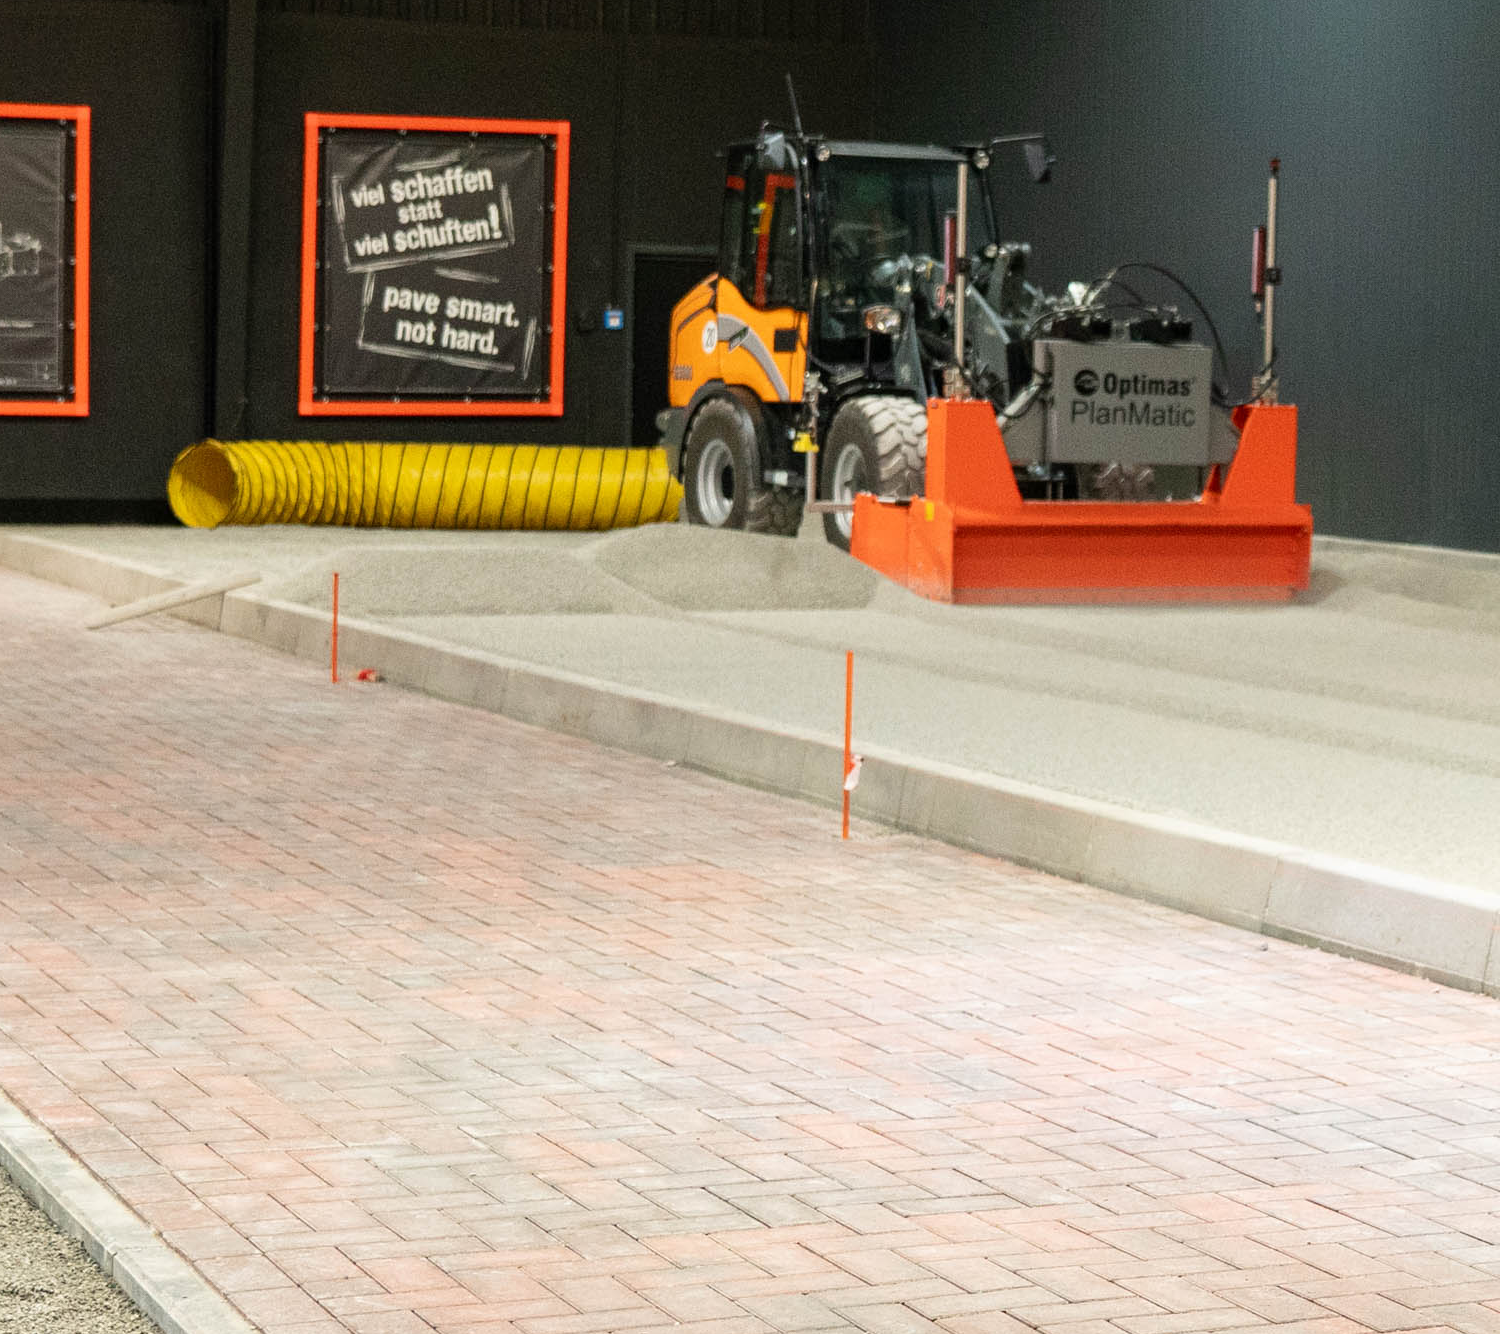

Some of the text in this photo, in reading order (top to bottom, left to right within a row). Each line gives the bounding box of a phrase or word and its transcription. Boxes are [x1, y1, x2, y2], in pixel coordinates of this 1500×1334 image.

[351, 168, 493, 207] viel schaffen
[354, 203, 502, 256] viel schuften!
[398, 200, 443, 223] statt
[382, 286, 520, 327] pave smart.
[396, 319, 499, 355] not hard.
[1103, 373, 1190, 398] Optimas
[1071, 400, 1196, 427] PlanMatic
